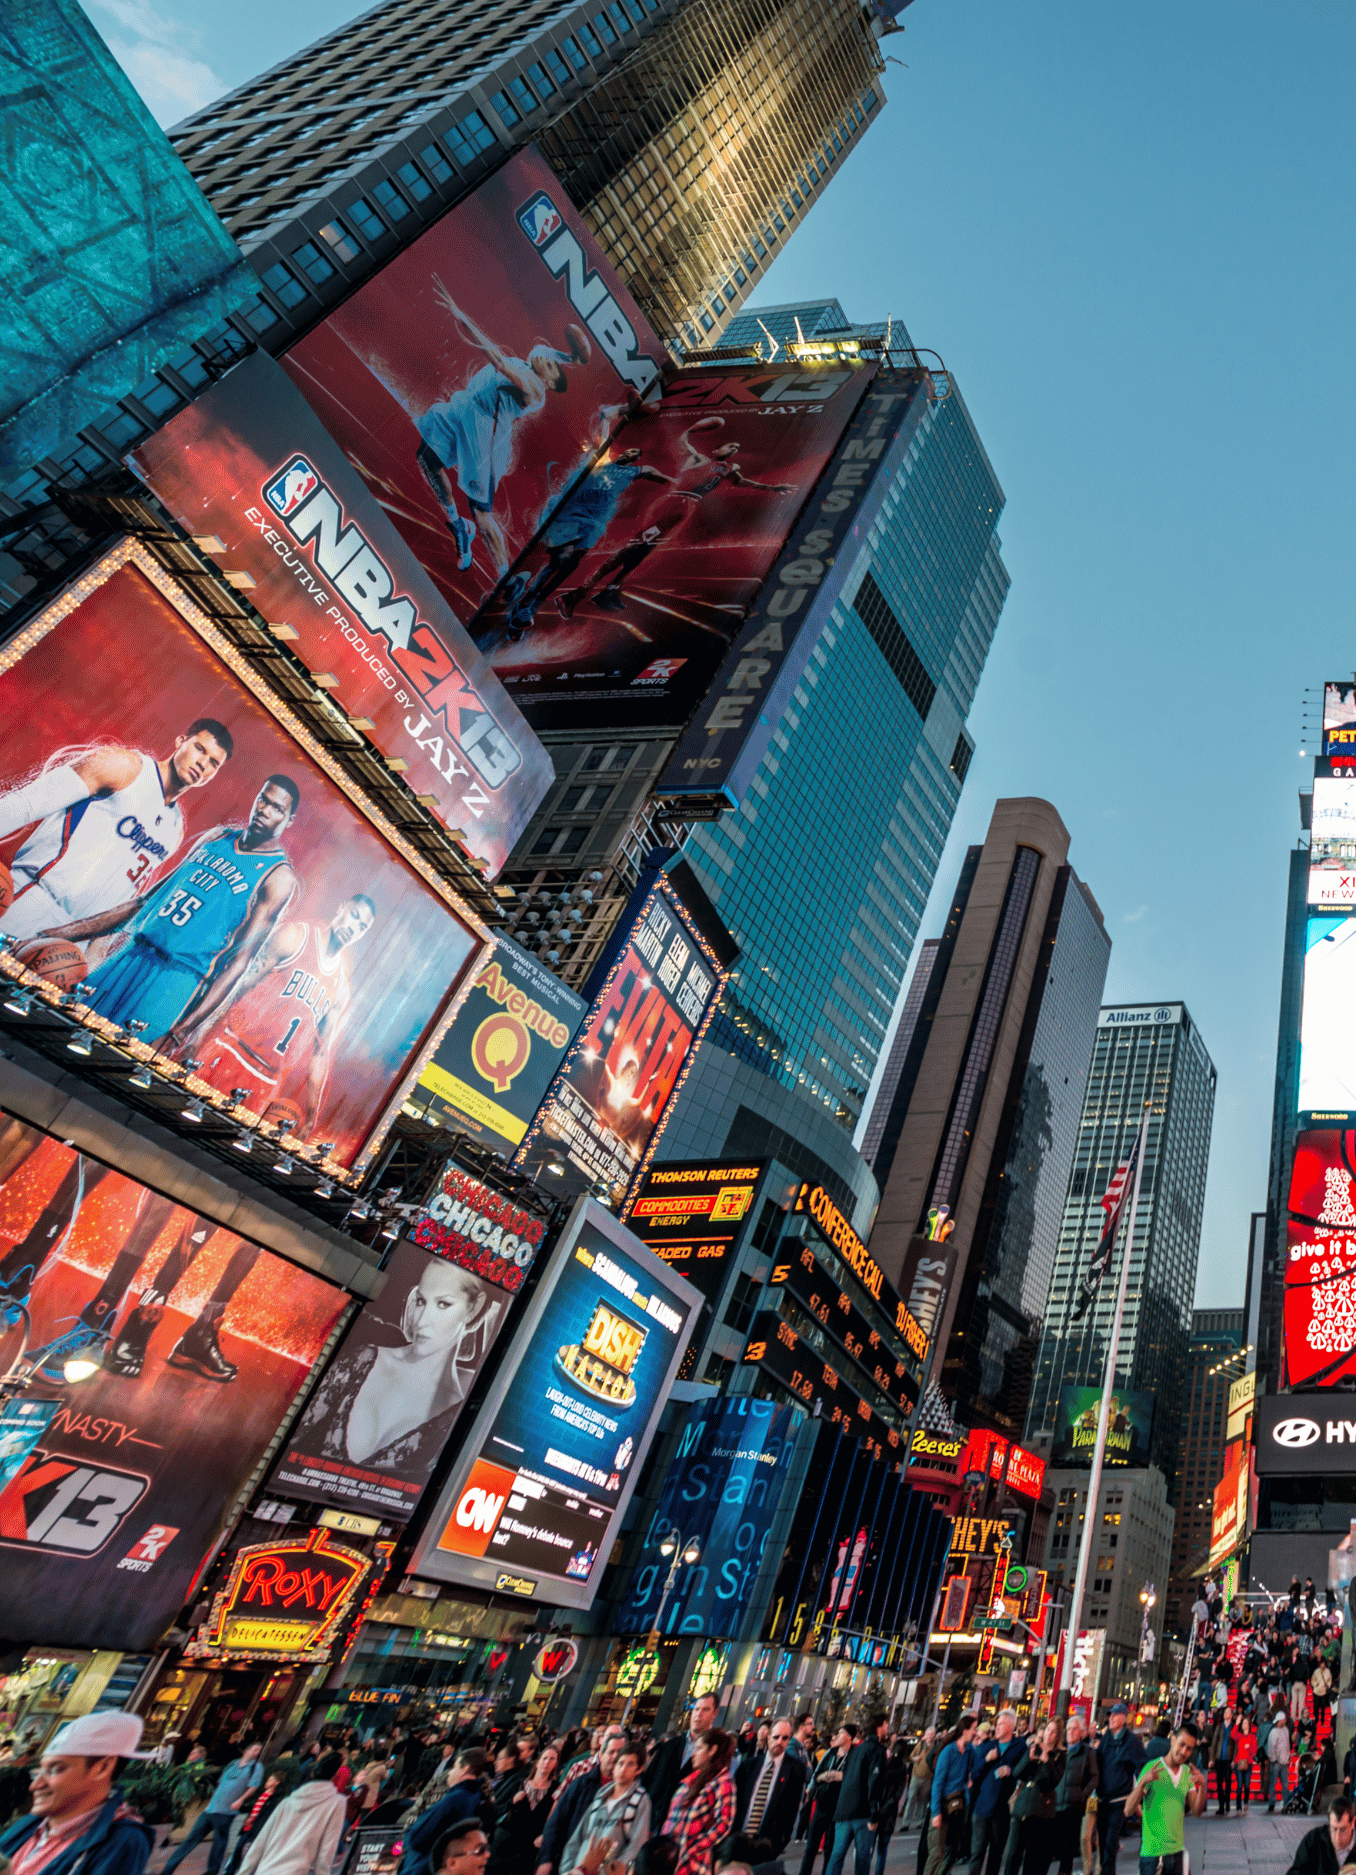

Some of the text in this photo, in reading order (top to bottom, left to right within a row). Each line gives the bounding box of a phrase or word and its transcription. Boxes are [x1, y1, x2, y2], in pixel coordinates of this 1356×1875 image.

[538, 228, 664, 400] NBA
[244, 505, 491, 818] EXECUTIVE PRODUCED BY JAY Z
[683, 757, 723, 770] NYC
[188, 868, 223, 894] CITY
[157, 889, 205, 928] 35
[476, 962, 571, 1050] Avenue
[1106, 1010, 1152, 1024] Allianz
[471, 1011, 532, 1094] Q
[651, 1167, 760, 1184] THOMSON REUTERS
[442, 1167, 546, 1244] CHICAGO
[639, 1198, 711, 1213] COMMODITIES
[649, 1216, 691, 1227] ENERGY
[430, 1192, 534, 1267] CHICAGO
[809, 1186, 885, 1301] CONFERENCE CALL
[414, 1217, 524, 1292] CHICAGO
[697, 1245, 726, 1258] GAS
[1290, 1240, 1325, 1261] give
[1329, 1239, 1343, 1256] it
[587, 1309, 646, 1375] DISH
[561, 1345, 636, 1402] NATION
[711, 1447, 778, 1467] Morgan Stanley
[116, 1557, 154, 1573] SPORTS
[230, 1626, 307, 1643] DELICATESSEN
